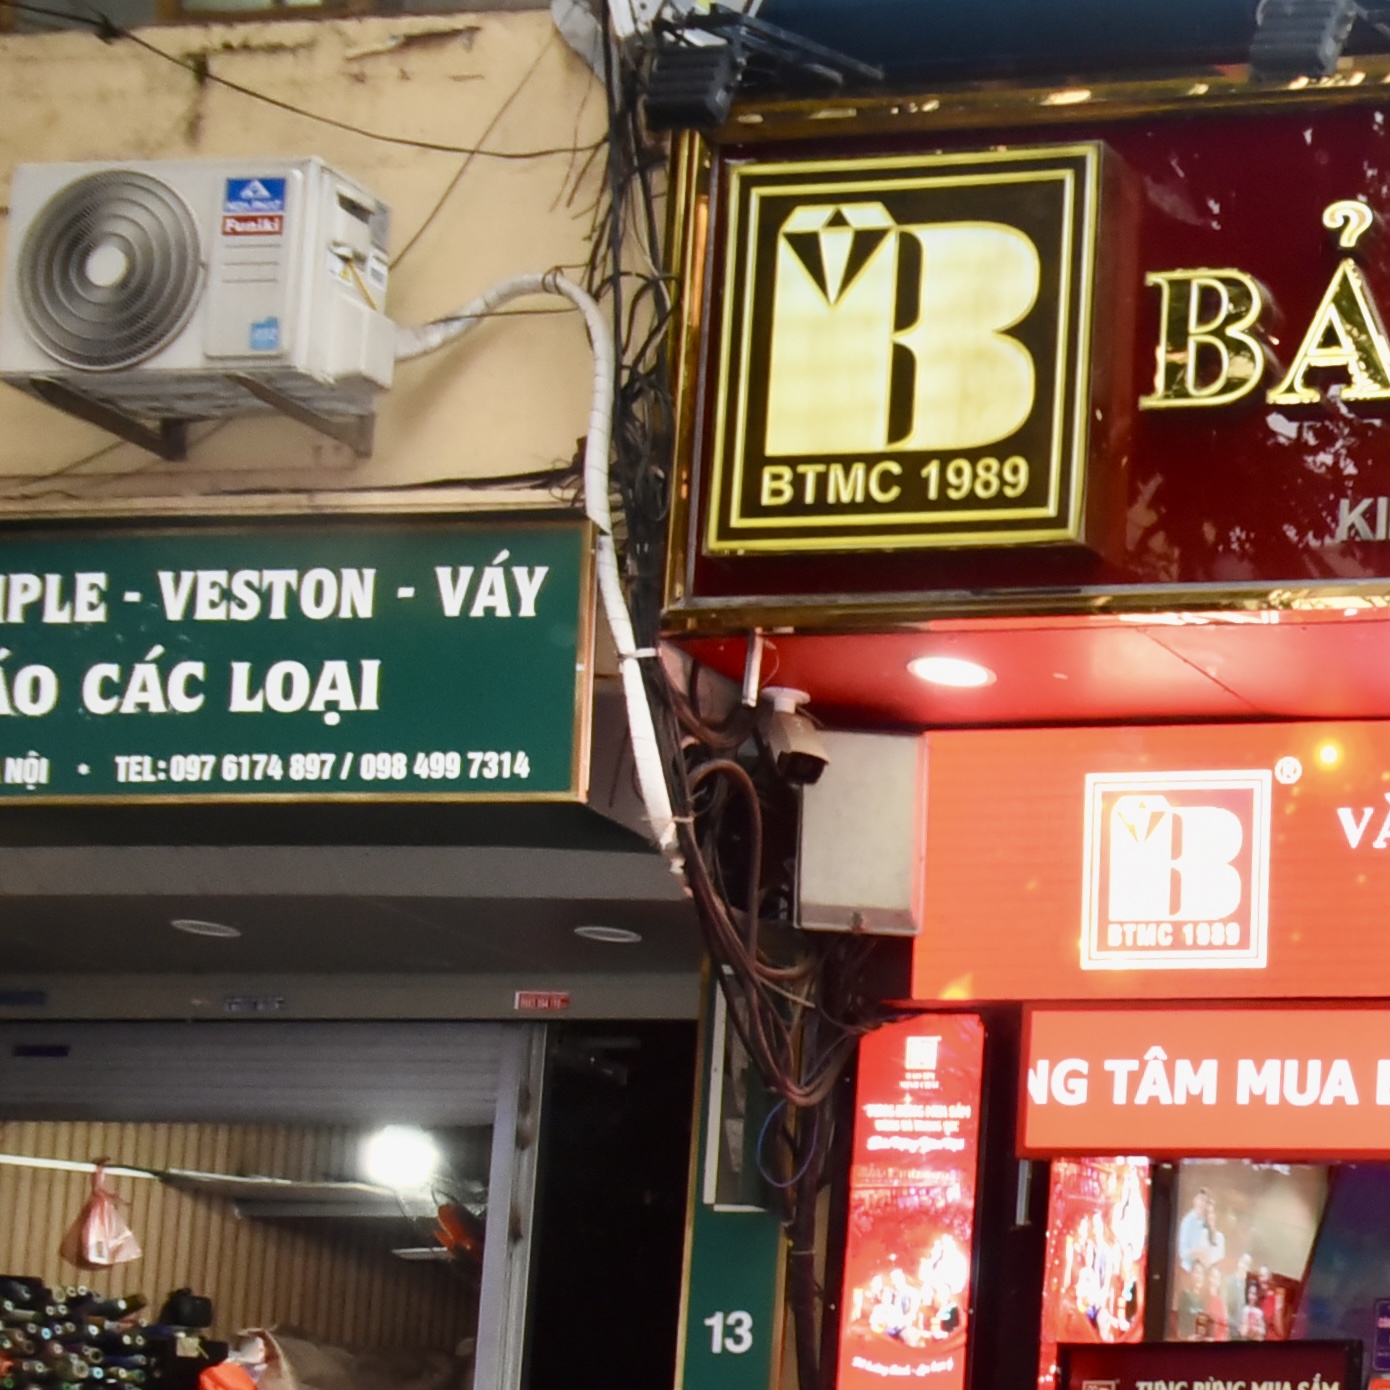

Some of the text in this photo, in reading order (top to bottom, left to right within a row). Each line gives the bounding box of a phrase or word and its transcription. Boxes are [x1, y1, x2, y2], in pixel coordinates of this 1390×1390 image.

[224, 217, 281, 233] Funiki
[760, 455, 1030, 507] BTMC 1989
[0, 572, 107, 623] PLE
[157, 567, 377, 621] VESTON
[434, 548, 550, 618] VÁY
[82, 644, 205, 715] CÁC
[228, 659, 382, 726] LOẠI
[4, 750, 49, 790] NỘI
[221, 753, 284, 781] 6174
[289, 752, 336, 781] 897
[359, 752, 408, 781] 098
[412, 751, 461, 780] 499
[467, 751, 531, 779] 7314
[1107, 923, 1173, 947] BTMC
[1103, 1045, 1218, 1106] TÂM
[1235, 1058, 1360, 1107] MUA
[704, 1310, 753, 1354] 13
